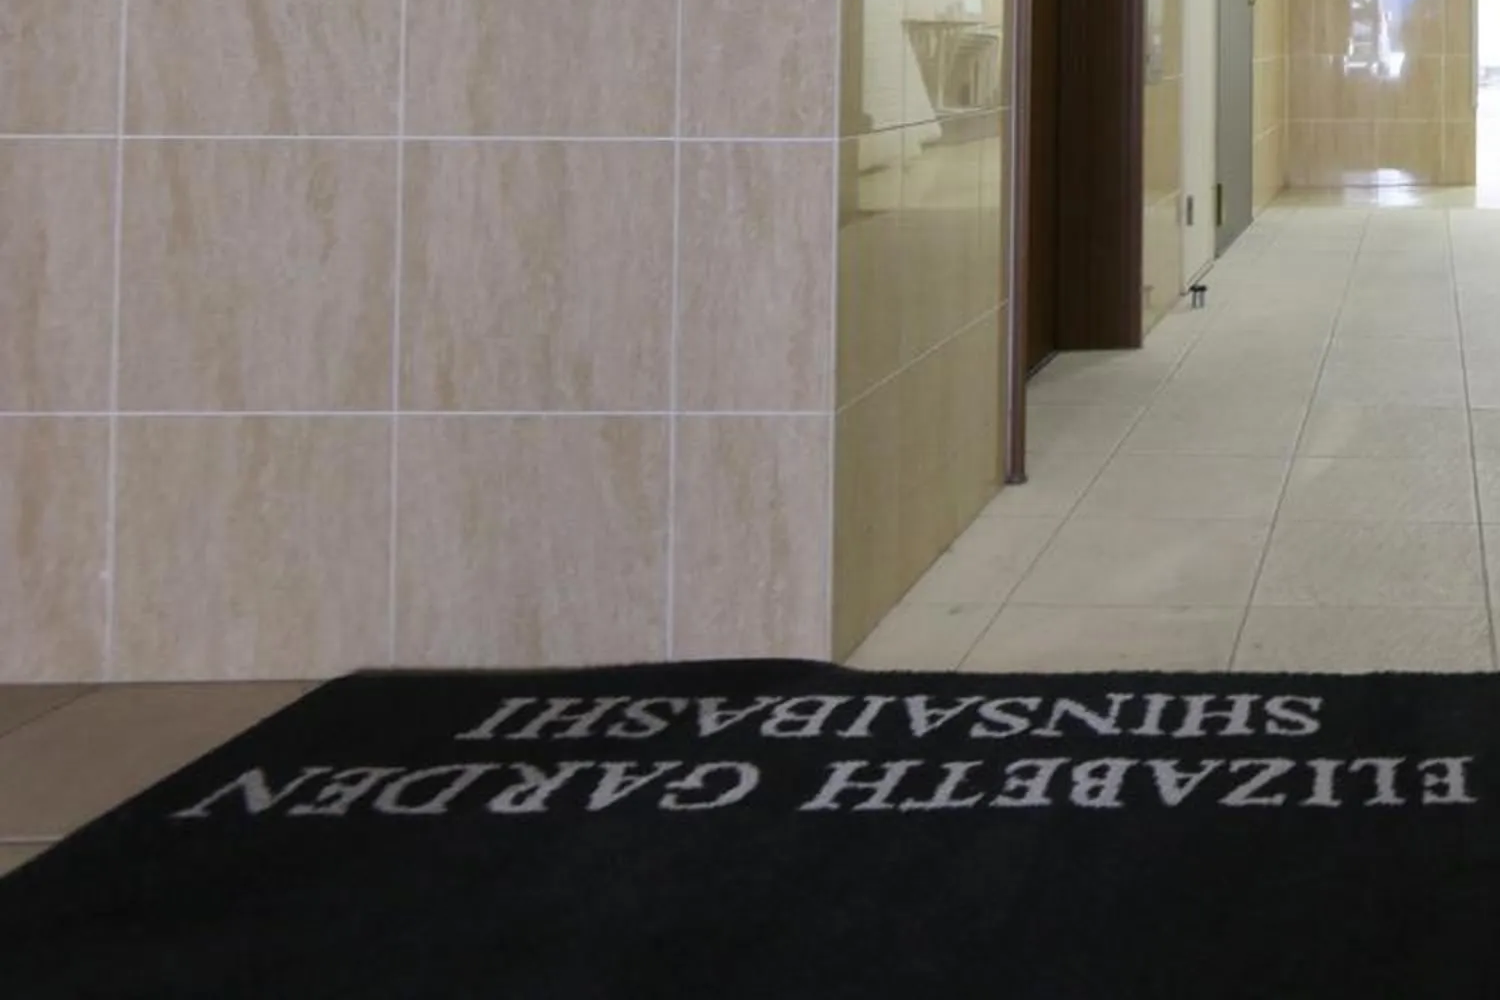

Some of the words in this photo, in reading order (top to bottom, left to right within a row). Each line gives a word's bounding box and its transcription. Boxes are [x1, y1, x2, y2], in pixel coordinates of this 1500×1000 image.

[455, 692, 1323, 740] SHINSAIBASHI
[172, 760, 760, 818] GARDEN
[798, 756, 1478, 811] ELIZABETH
